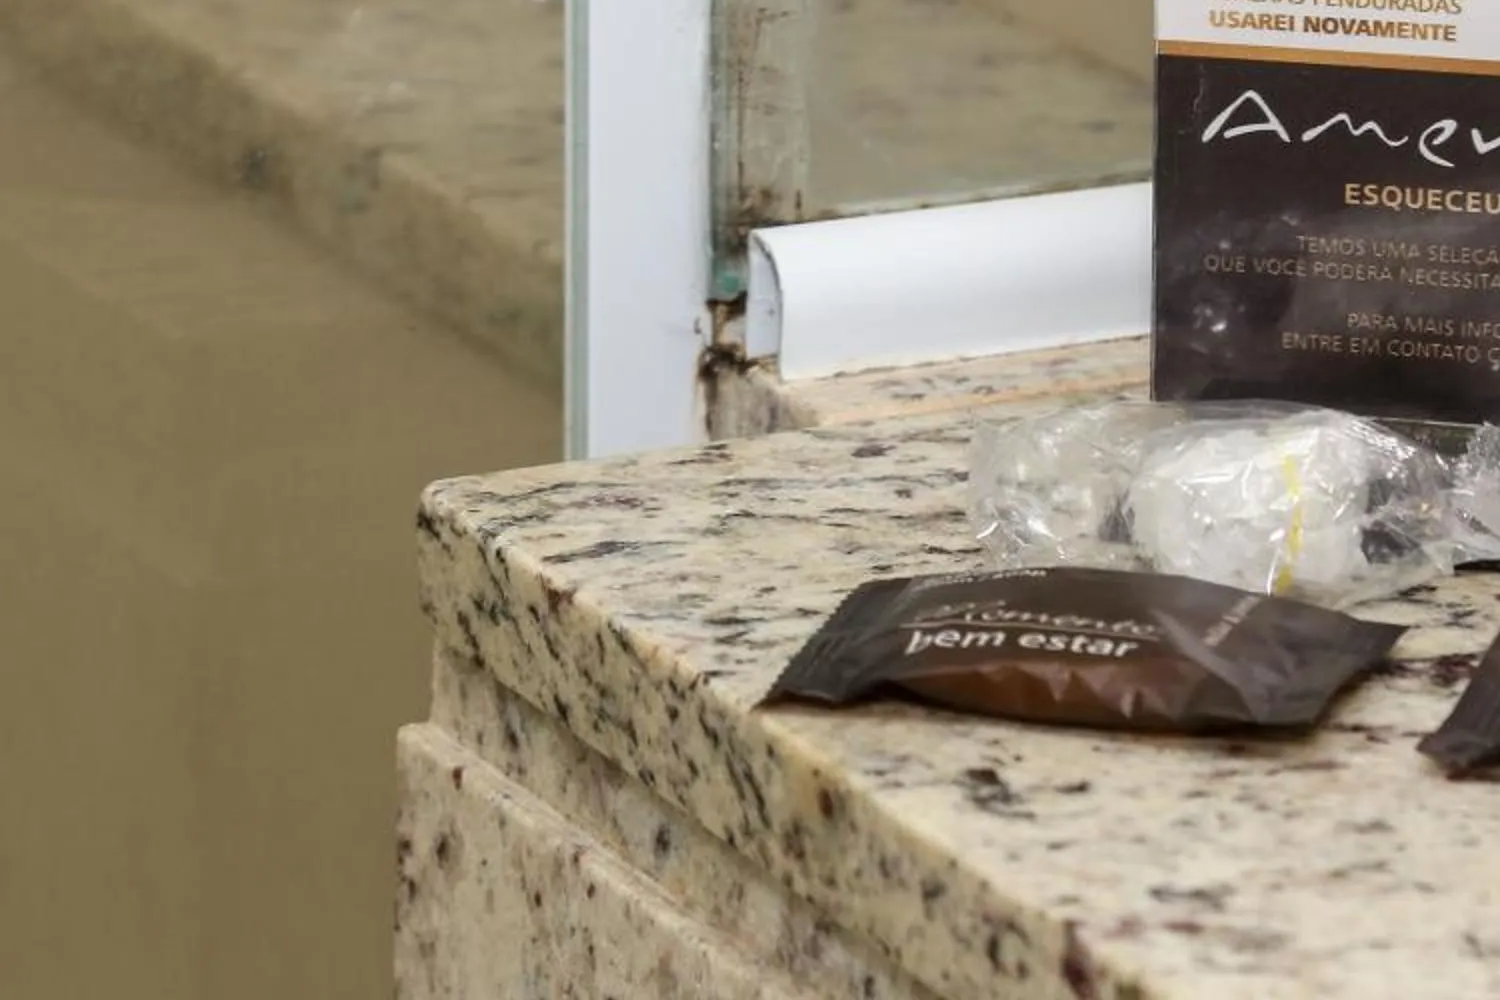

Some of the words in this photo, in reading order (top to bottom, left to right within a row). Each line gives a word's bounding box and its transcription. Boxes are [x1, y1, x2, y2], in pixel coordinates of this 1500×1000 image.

[1209, 10, 1295, 32] USAREI
[1303, 15, 1457, 42] NOVAMENTE
[1296, 235, 1366, 257] TEMOS
[1372, 240, 1420, 259] UMA
[1204, 254, 1246, 273] QUE
[1347, 312, 1397, 330] PARA
[1405, 316, 1454, 336] MAIS
[1282, 331, 1342, 351] ENTRE
[1350, 336, 1381, 355] EM
[1387, 338, 1481, 363] CONTATO
[1018, 631, 1139, 658] estar
